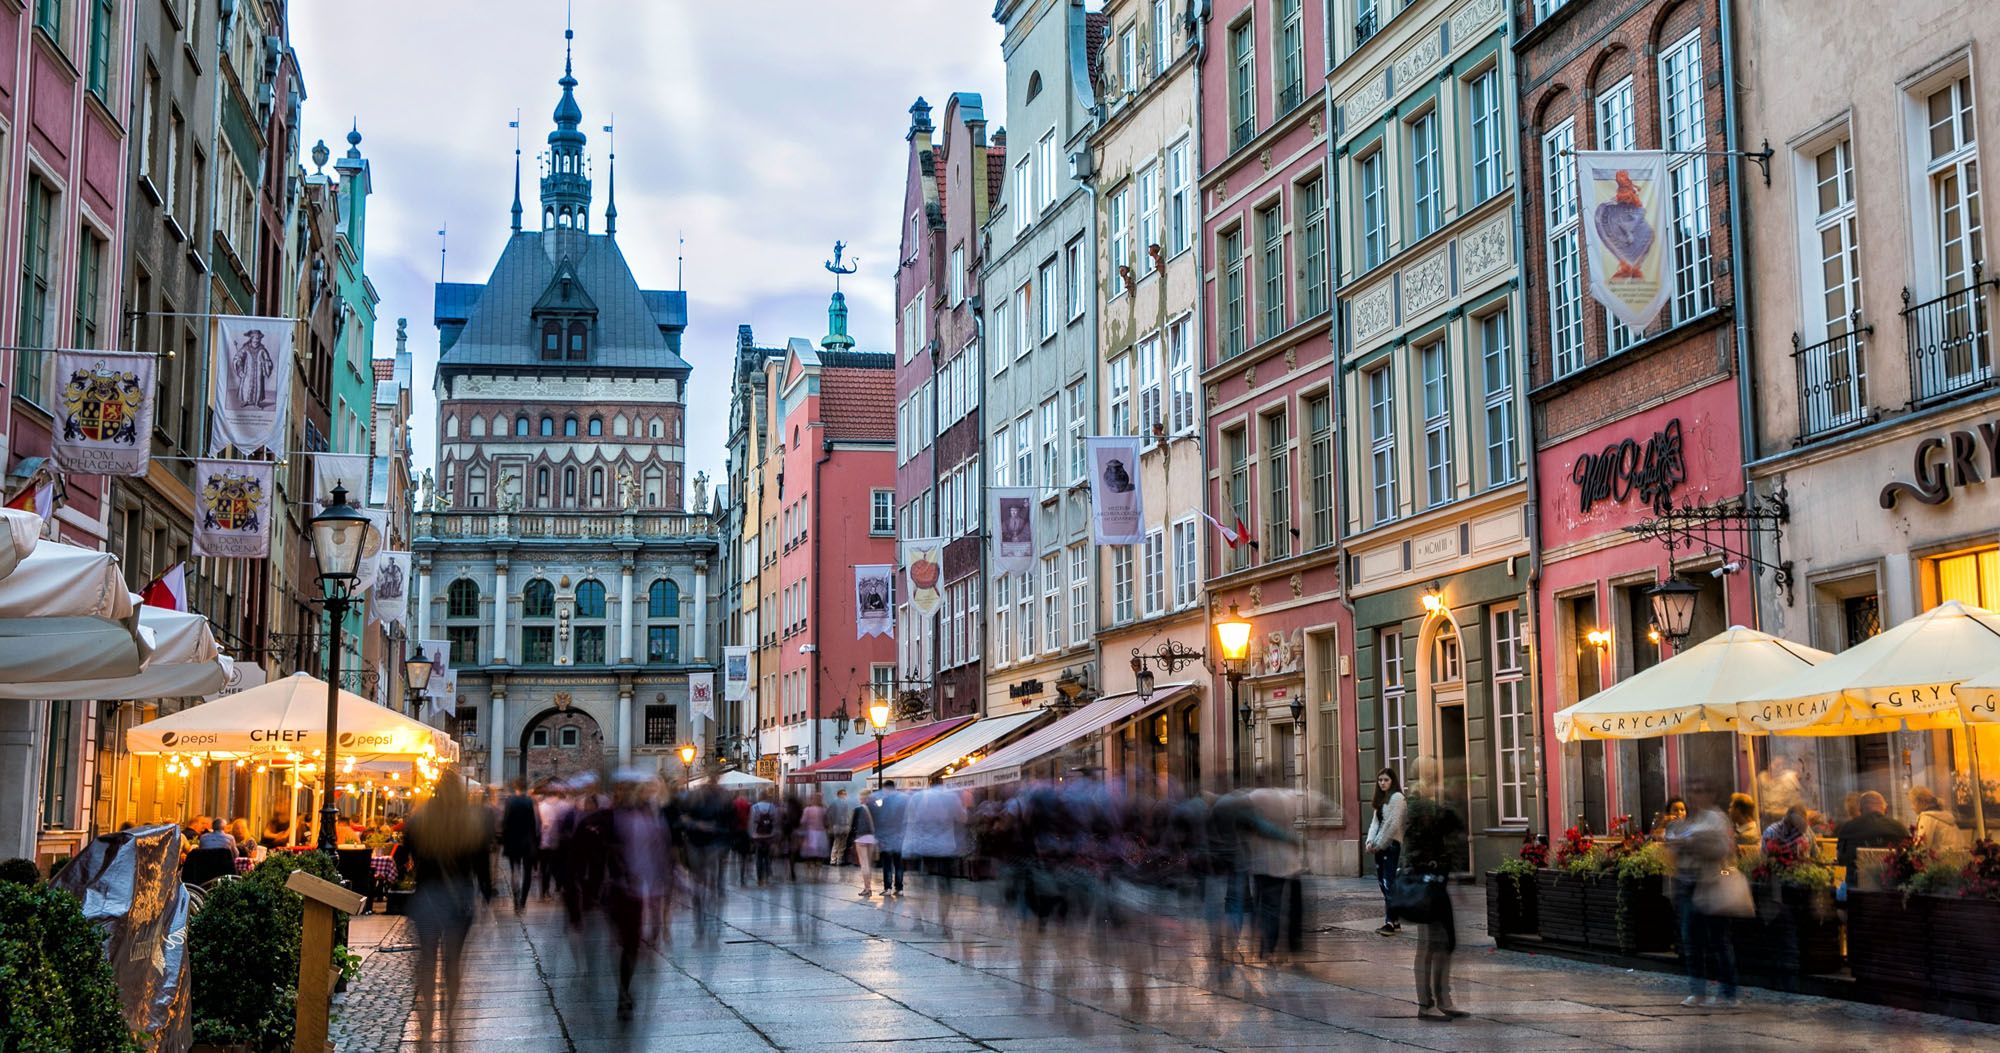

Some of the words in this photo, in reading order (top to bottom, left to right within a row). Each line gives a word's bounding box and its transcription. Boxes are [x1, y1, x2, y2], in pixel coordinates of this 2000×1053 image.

[82, 448, 114, 460] DOM
[61, 457, 134, 471] UPHAGENA
[1573, 443, 1619, 514] Wild
[219, 536, 243, 545] DOM
[1750, 699, 1829, 722] GRYCAN
[1590, 711, 1683, 732] GRYCAN
[181, 733, 218, 746] pepsi
[250, 729, 308, 742] CHEF
[357, 734, 393, 747] pepsi
